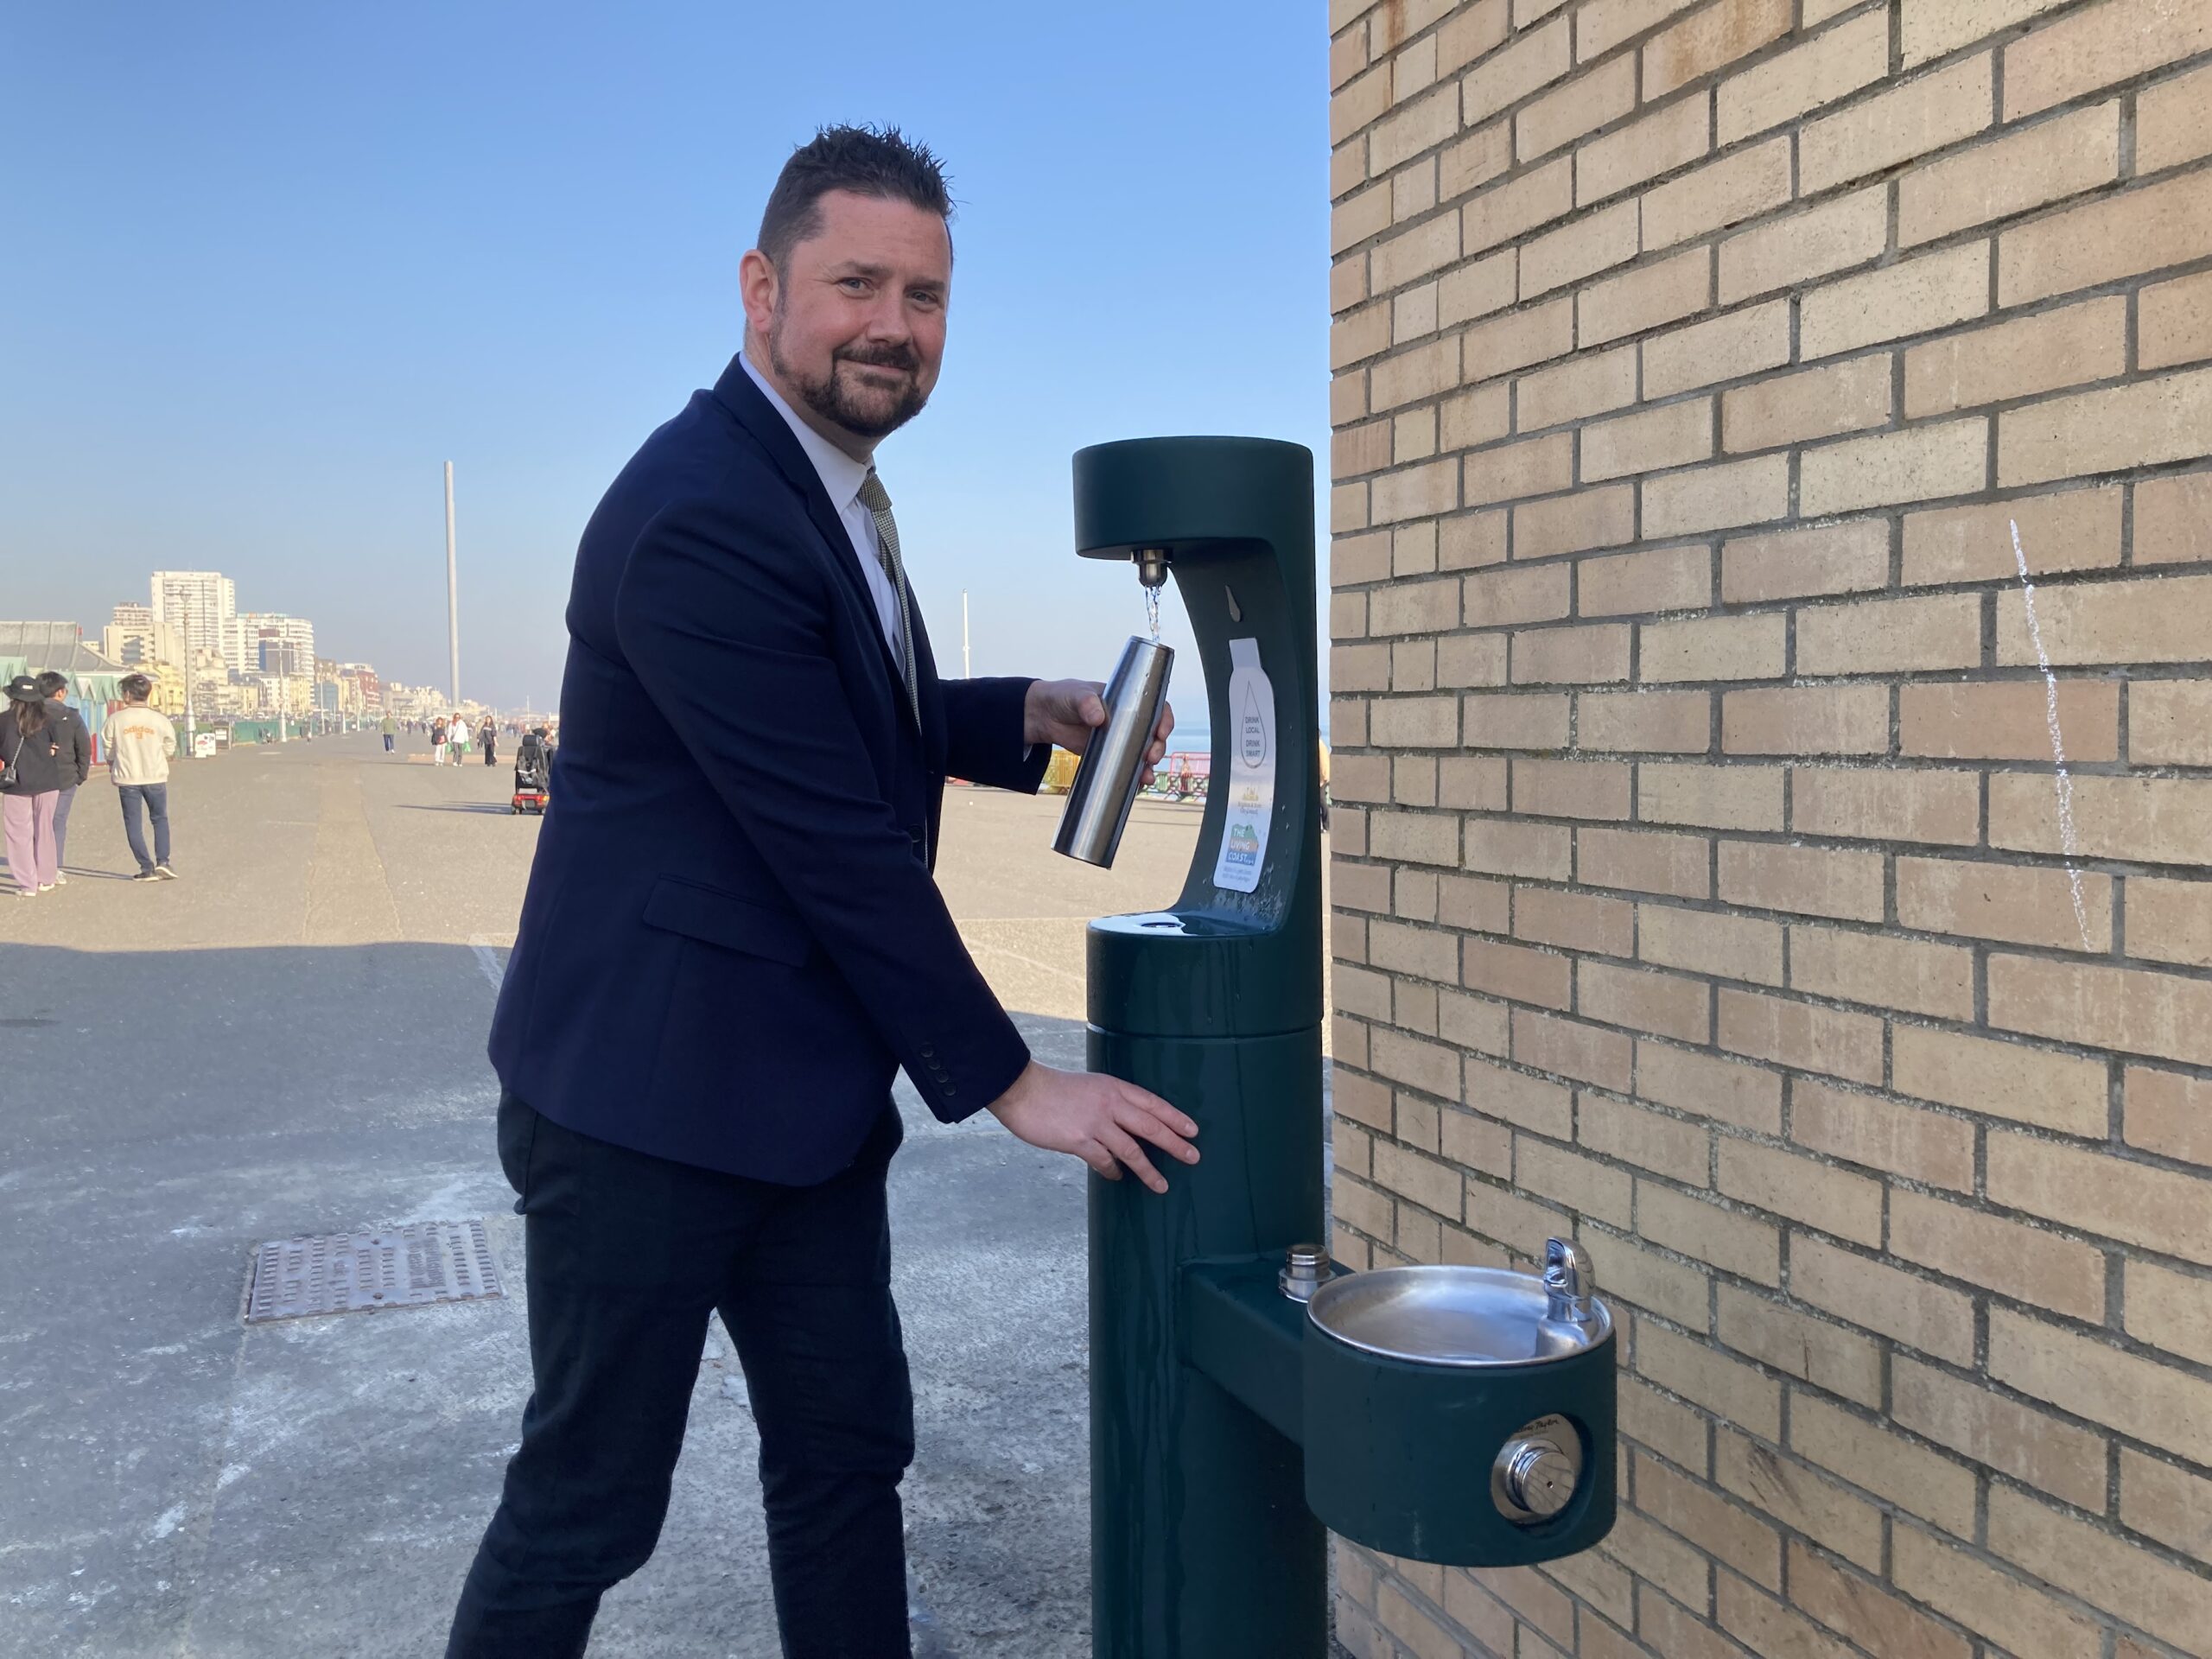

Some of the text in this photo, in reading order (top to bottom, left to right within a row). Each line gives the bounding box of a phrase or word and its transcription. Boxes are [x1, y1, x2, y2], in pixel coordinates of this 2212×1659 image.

[123, 726, 155, 734] adidas
[1233, 828, 1245, 837] THE
[1230, 840, 1250, 851] LIVING
[1228, 852, 1248, 862] COAST
